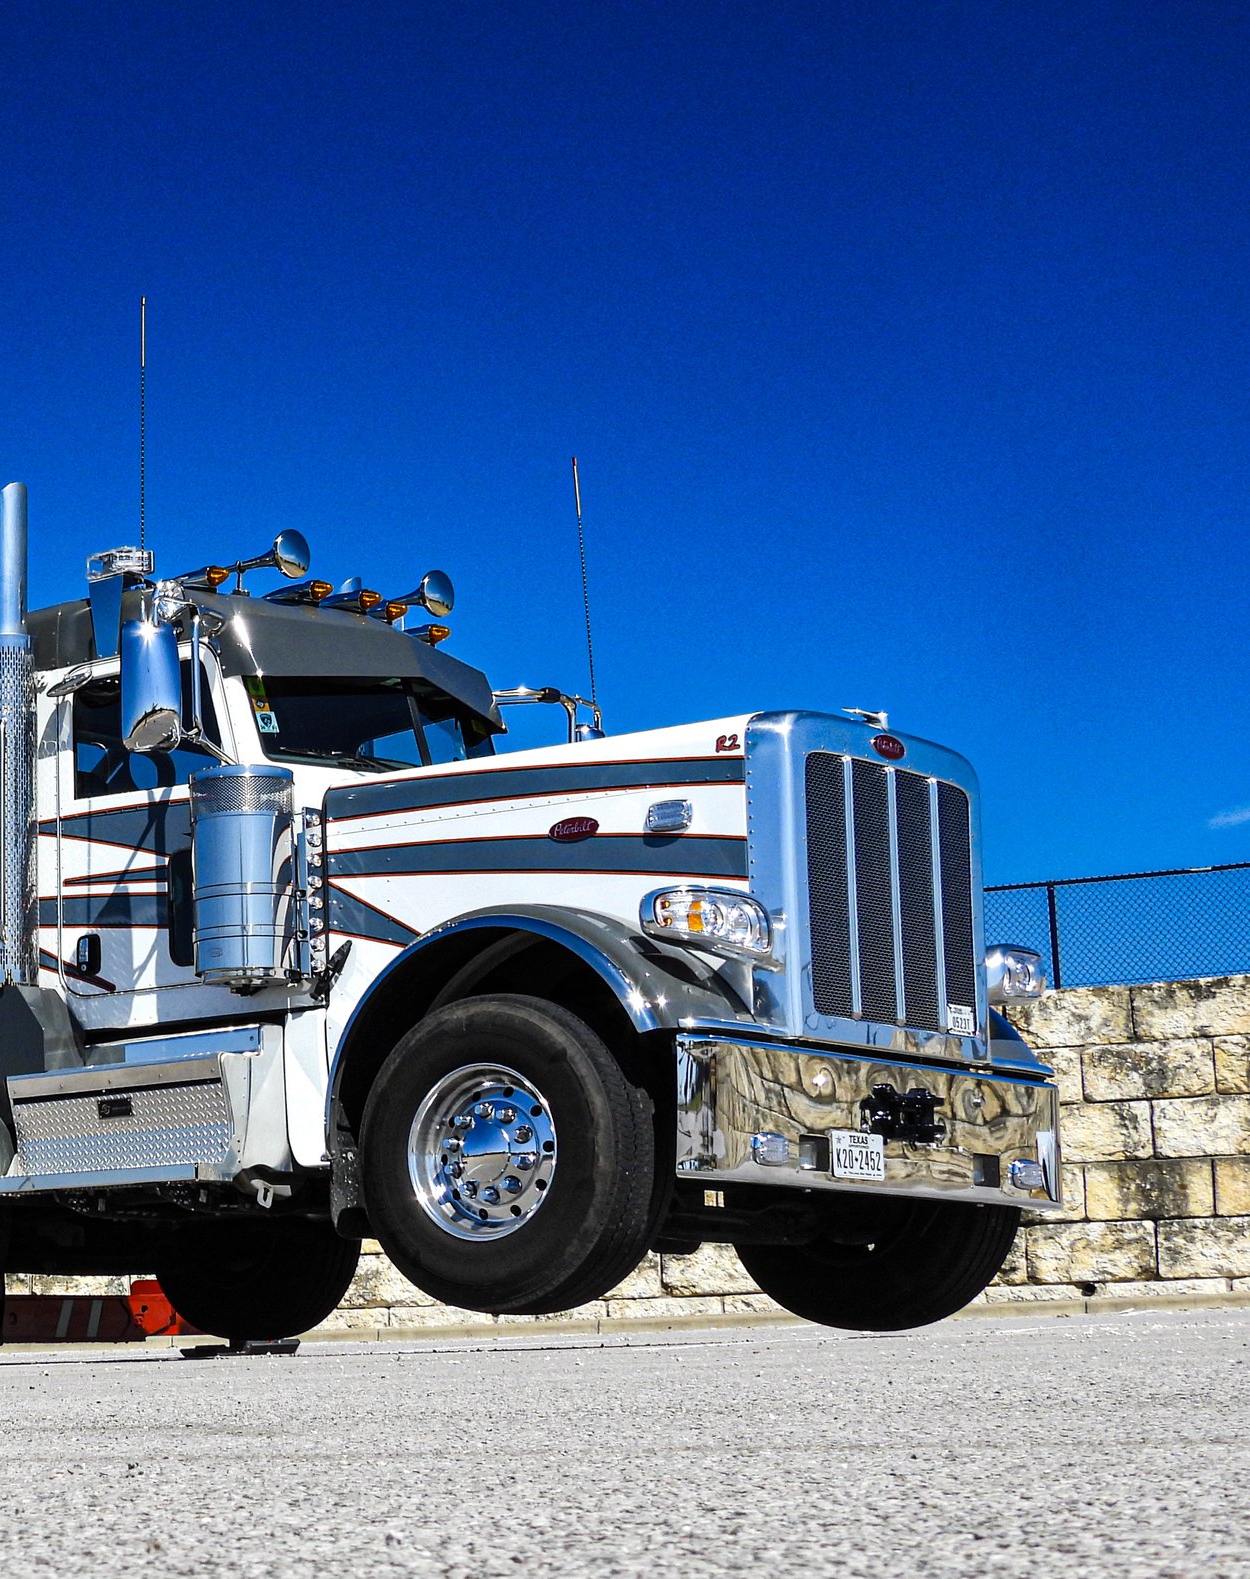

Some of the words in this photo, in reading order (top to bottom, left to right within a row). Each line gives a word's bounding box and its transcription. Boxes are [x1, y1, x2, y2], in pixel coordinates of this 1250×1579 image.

[715, 733, 741, 753] R2
[553, 820, 595, 837] Peterbilt
[849, 1134, 869, 1145] TEXAS
